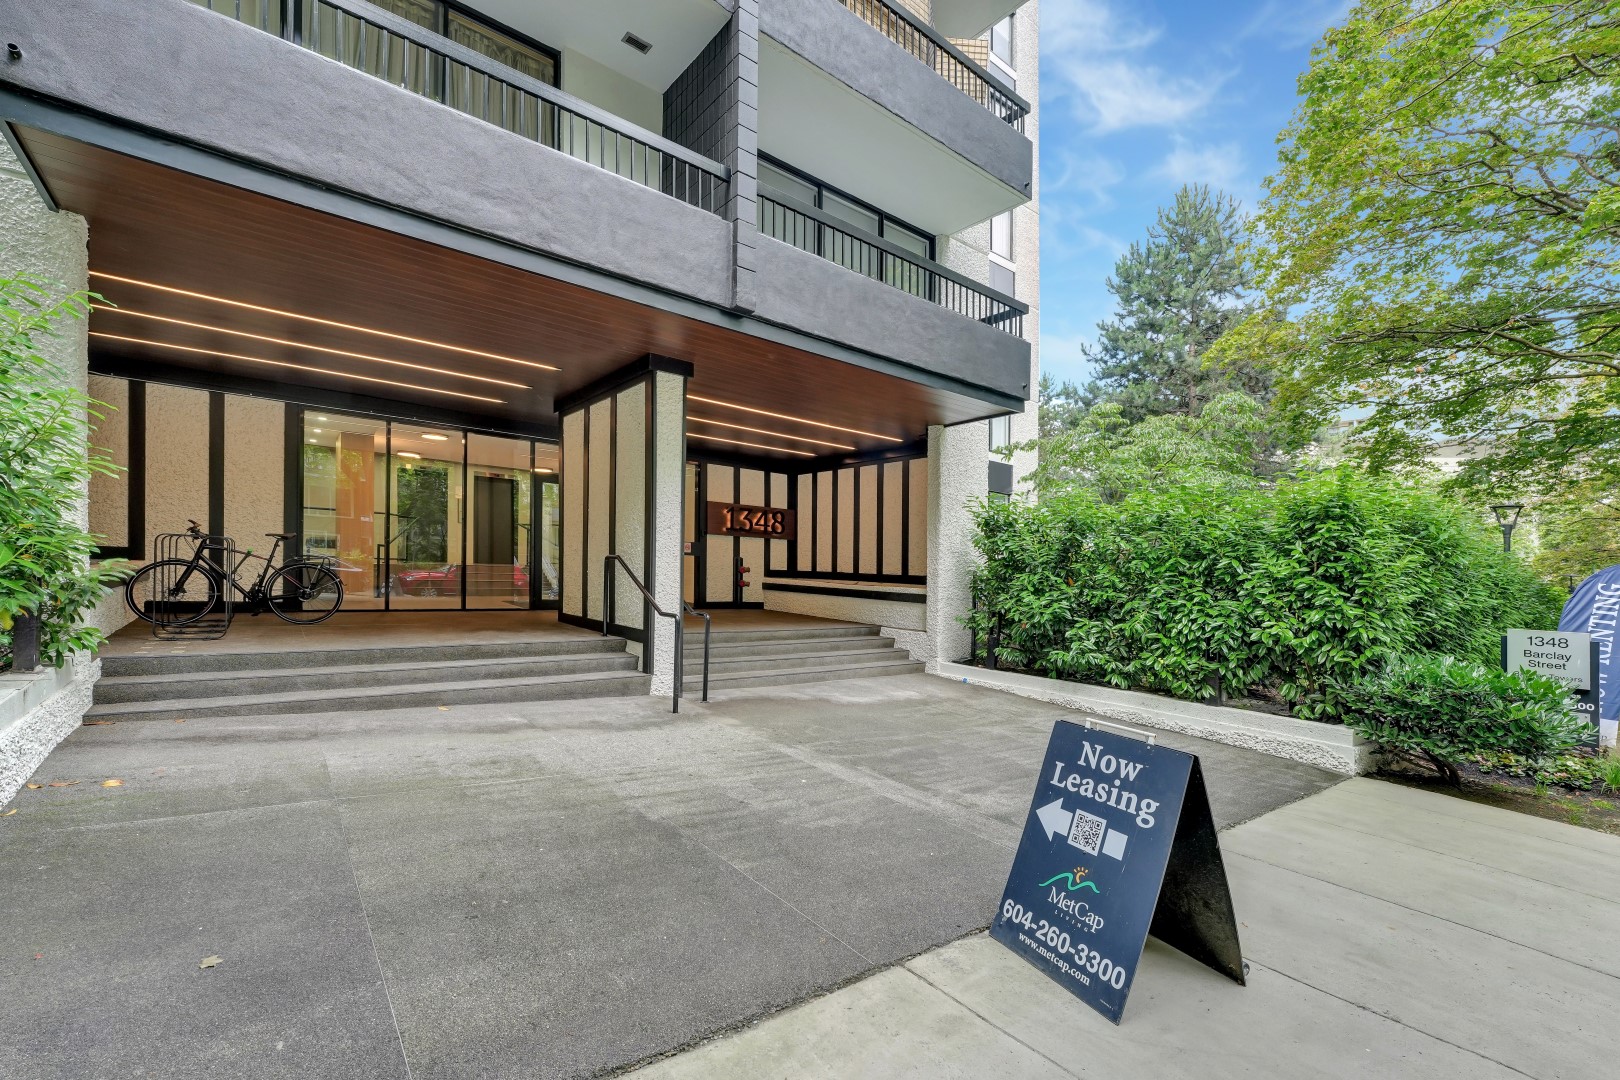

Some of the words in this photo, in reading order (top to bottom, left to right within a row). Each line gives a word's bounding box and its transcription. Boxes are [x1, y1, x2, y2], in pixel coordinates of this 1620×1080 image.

[725, 506, 786, 535] 1348
[1523, 649, 1572, 663] Barclay
[1527, 636, 1569, 649] 1348
[1528, 660, 1567, 671] Street
[1077, 741, 1144, 782] Now
[1050, 761, 1160, 829] Leasing
[1047, 886, 1104, 933] MetCap
[1003, 899, 1126, 990] 604-260-3300
[1019, 932, 1090, 987] www.metcap.com
